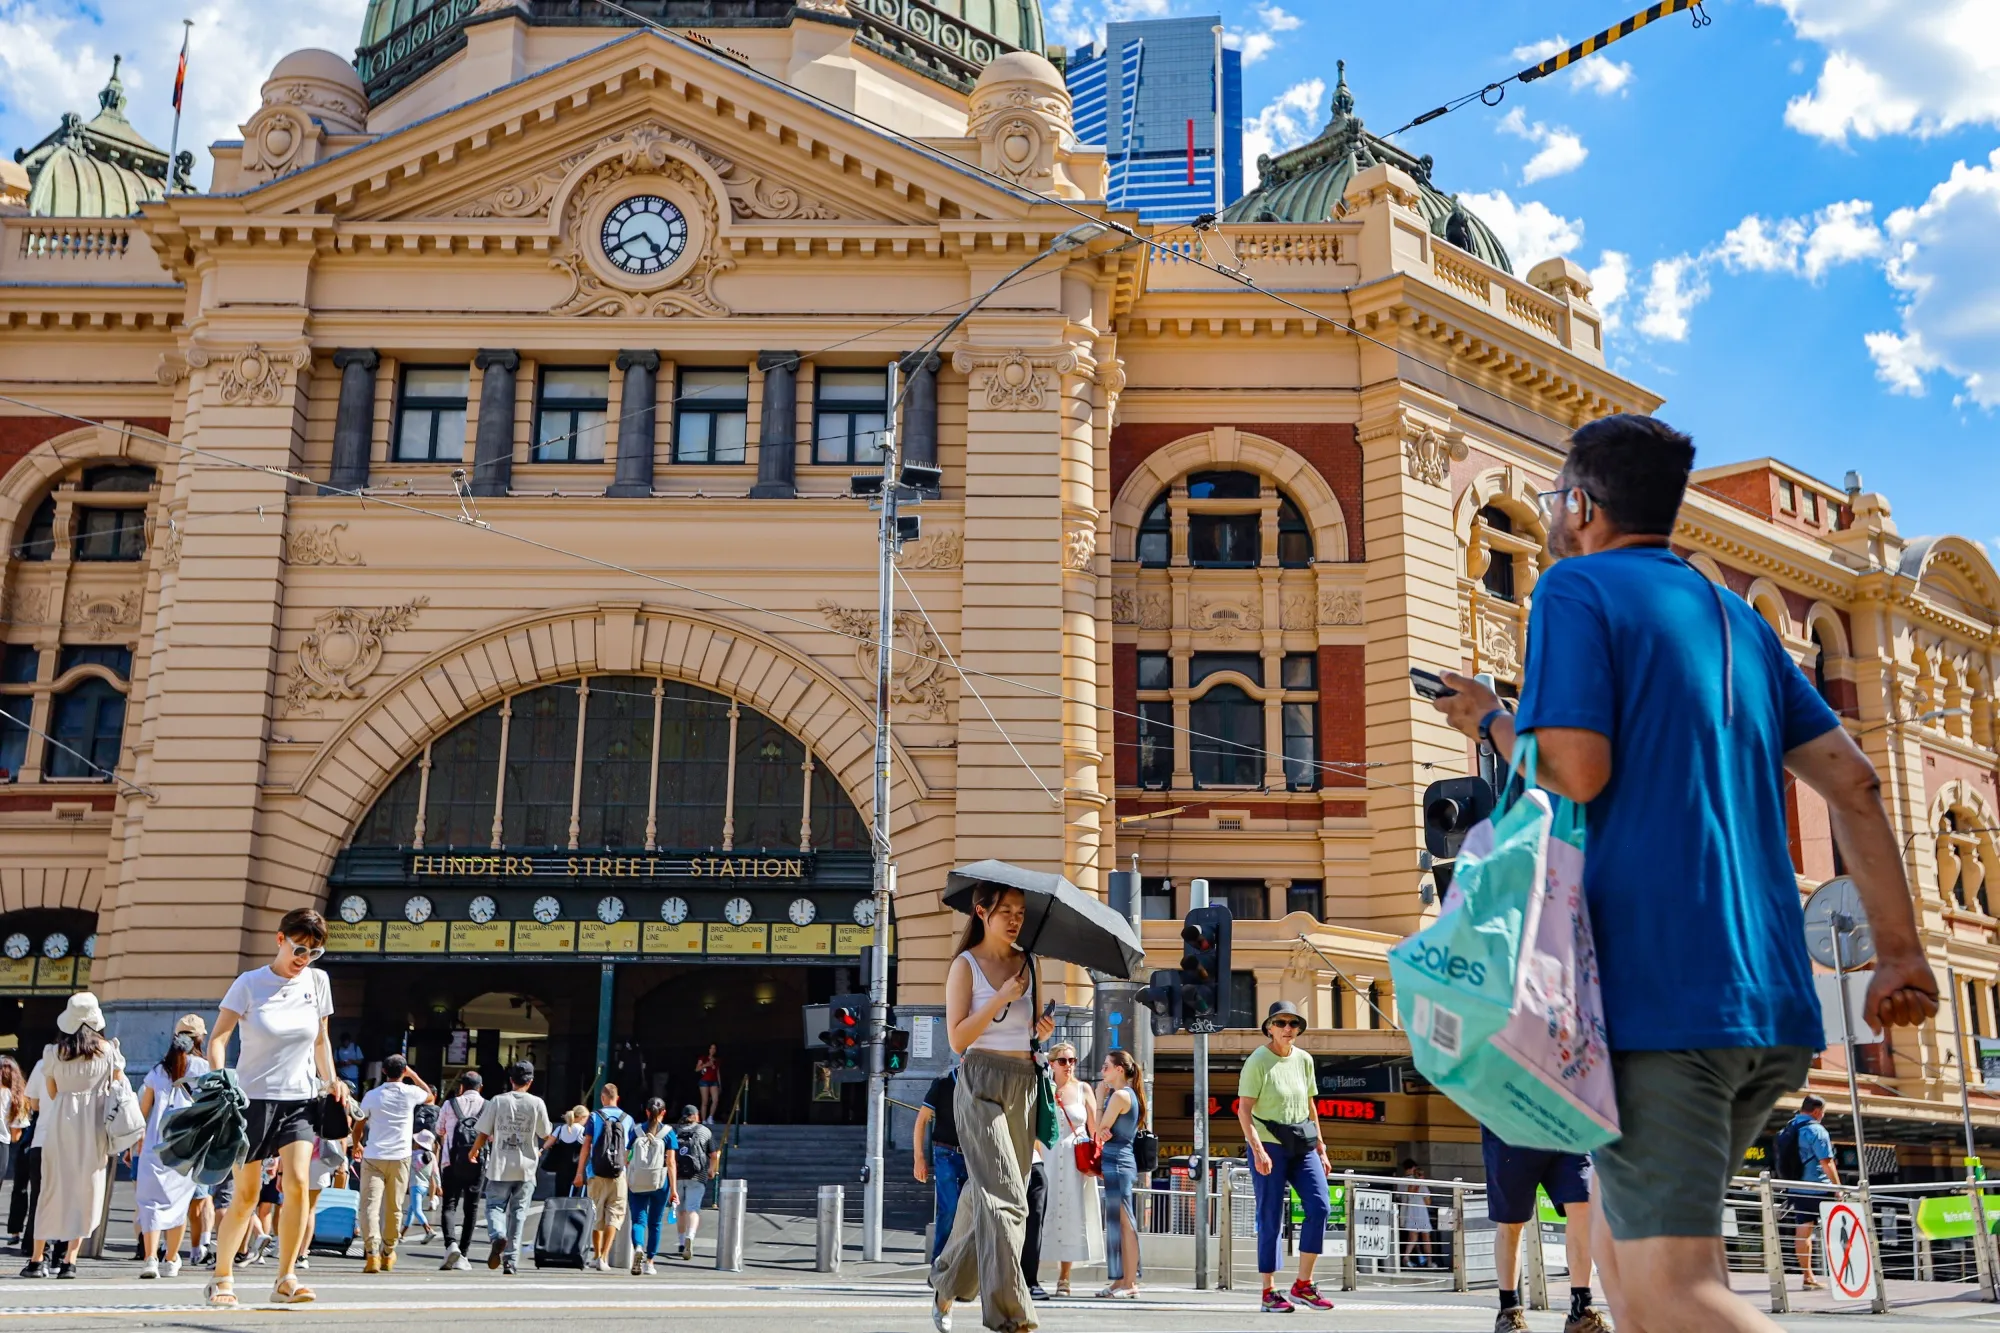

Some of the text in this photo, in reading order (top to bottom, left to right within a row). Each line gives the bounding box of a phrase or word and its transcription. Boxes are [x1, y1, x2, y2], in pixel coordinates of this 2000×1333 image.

[412, 856, 802, 878] FLINDERS STREET STATION
[1318, 1100, 1375, 1119] ATTERS
[1159, 1144, 1230, 1157] AKURA
[1360, 1196, 1385, 1212] WATCH
[1364, 1216, 1380, 1231] FOR
[1340, 1244, 1344, 1252] 5
[1359, 1236, 1384, 1251] TRAMS
